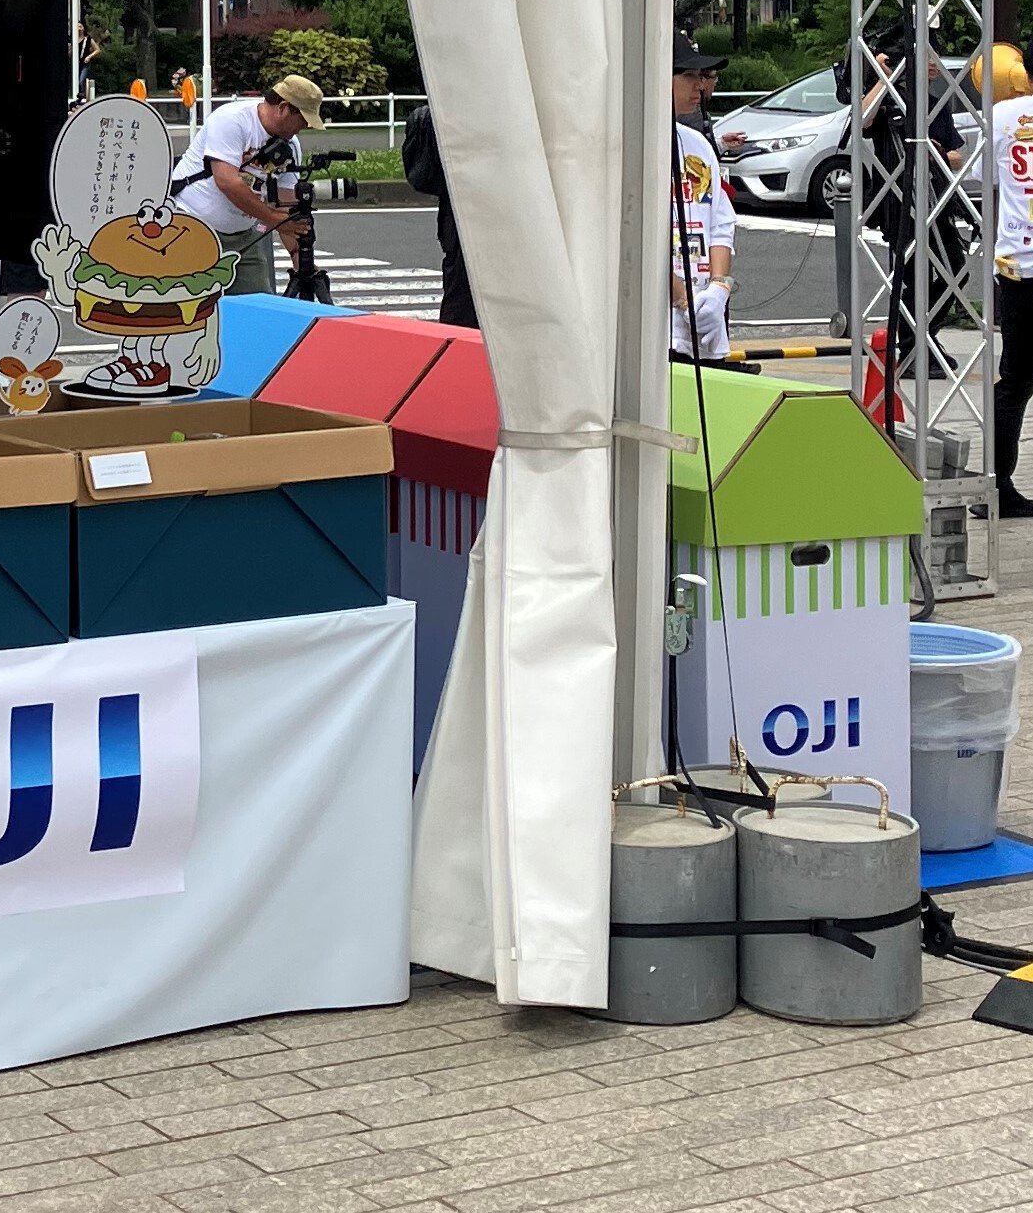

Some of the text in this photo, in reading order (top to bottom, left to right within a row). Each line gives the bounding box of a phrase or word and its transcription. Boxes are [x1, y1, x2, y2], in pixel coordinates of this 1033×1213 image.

[106, 119, 124, 215] このペットボトルは
[1011, 144, 1033, 177] S
[24, 316, 43, 355] うんうん
[761, 696, 861, 756] OJI
